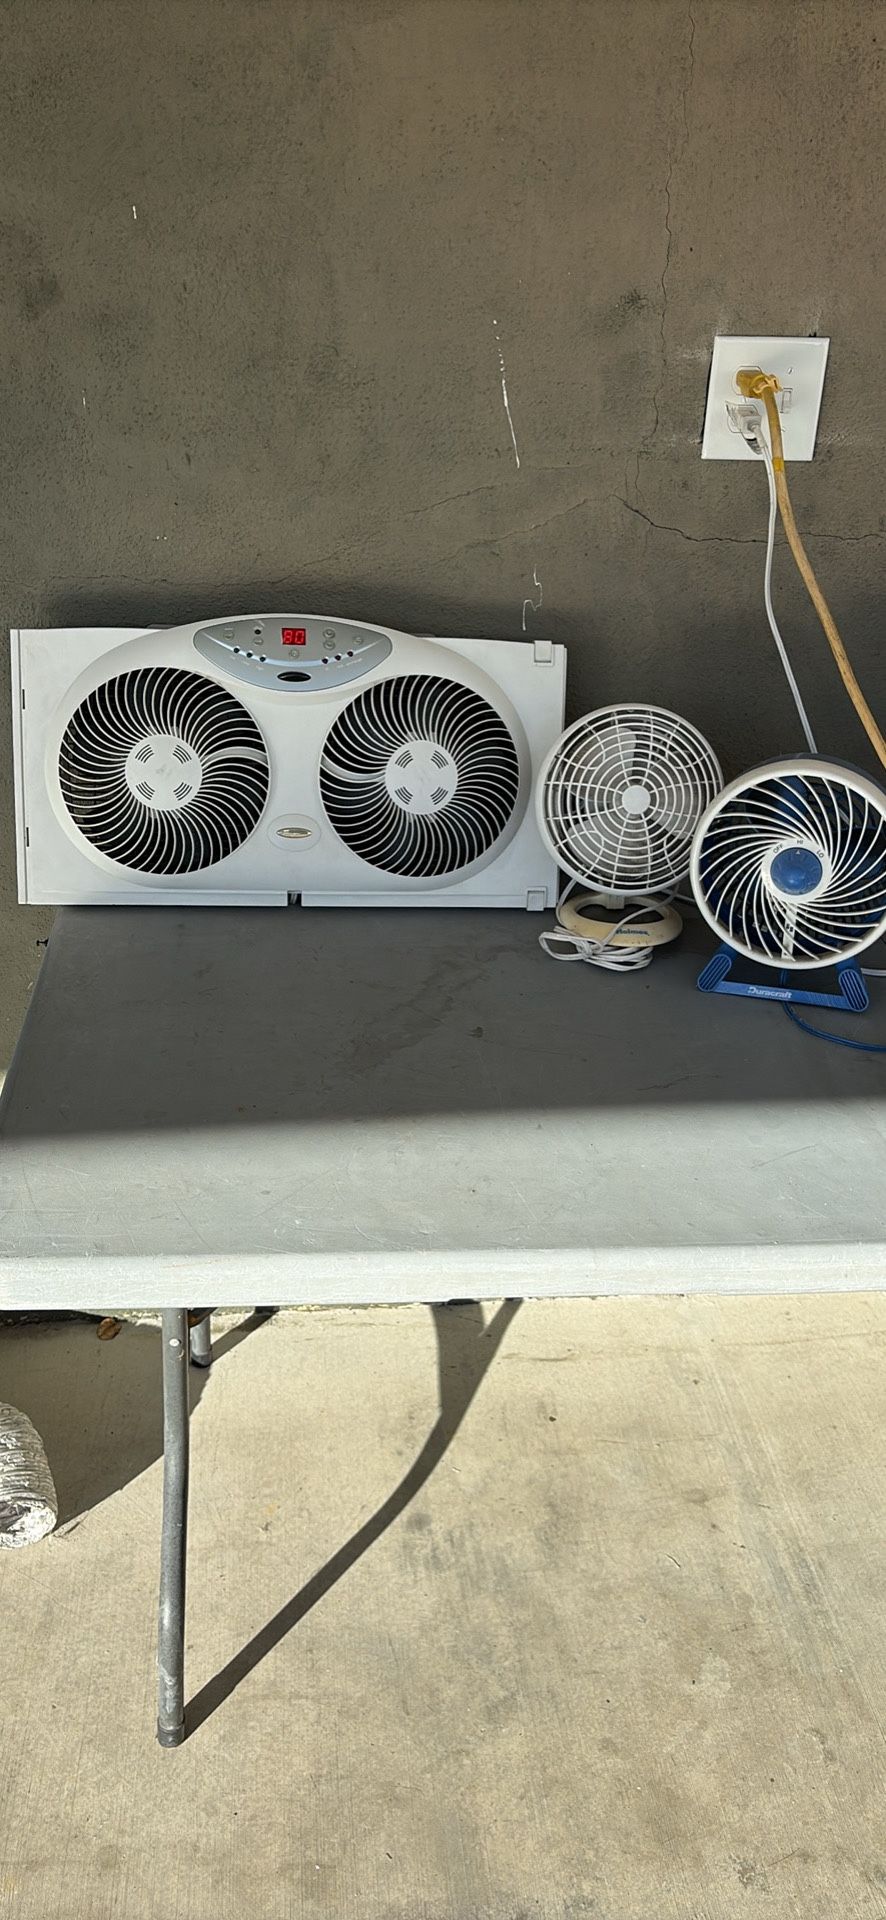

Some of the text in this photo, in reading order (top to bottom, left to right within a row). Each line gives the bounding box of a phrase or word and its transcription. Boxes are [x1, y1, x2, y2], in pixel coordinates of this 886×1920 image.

[284, 630, 304, 643] 80
[773, 844, 784, 854] OFF
[816, 849, 824, 858] LO
[748, 986, 792, 999] Duracraft
